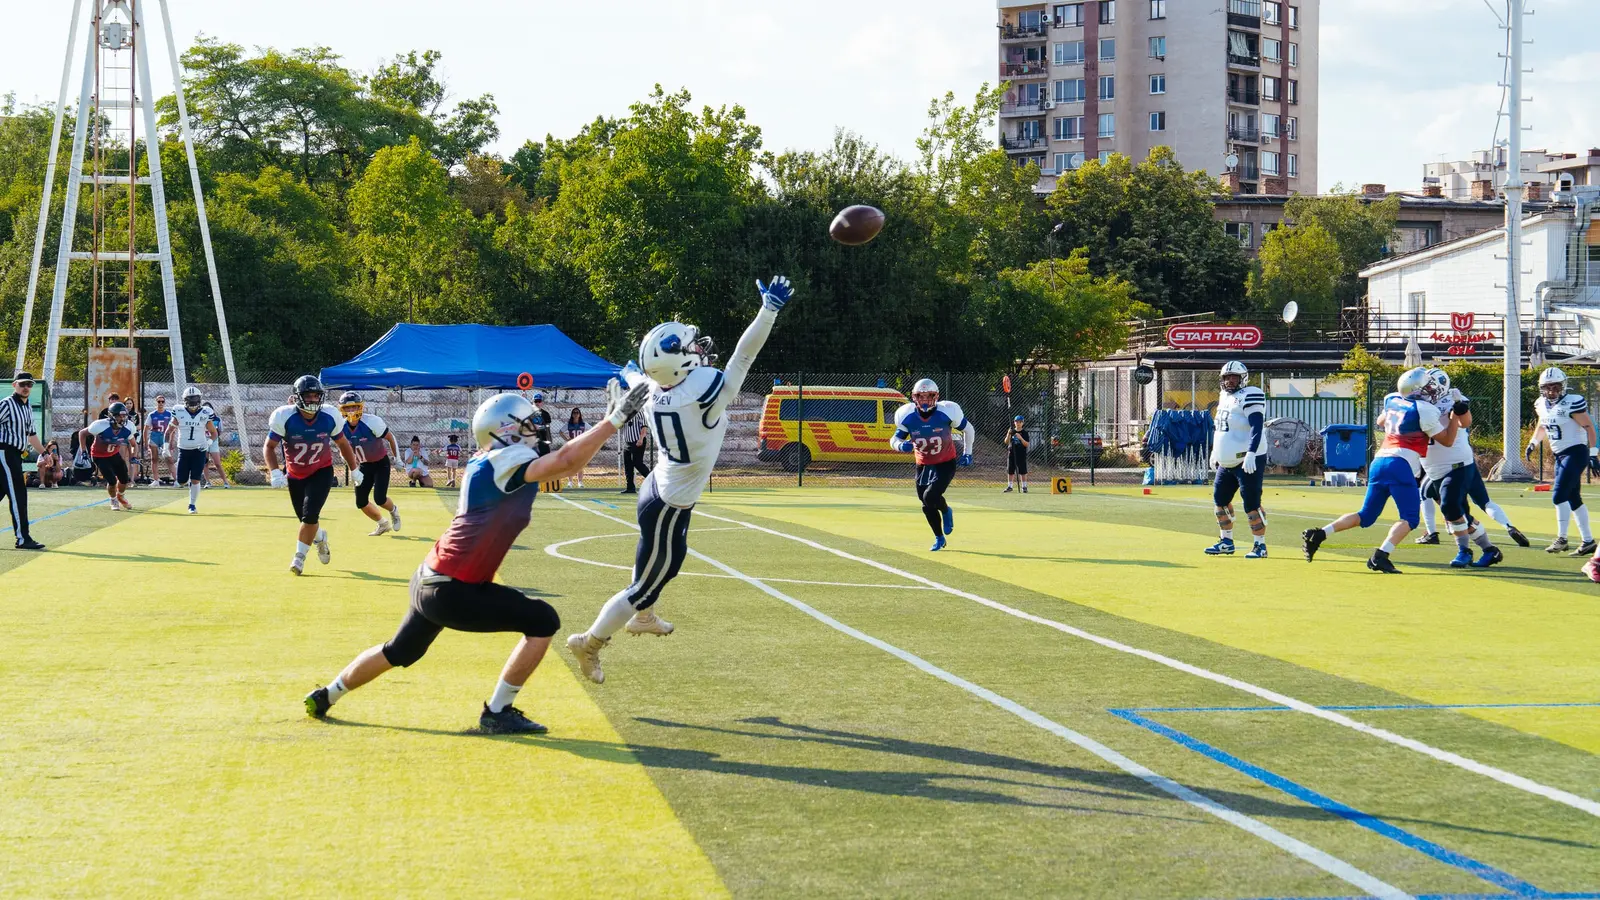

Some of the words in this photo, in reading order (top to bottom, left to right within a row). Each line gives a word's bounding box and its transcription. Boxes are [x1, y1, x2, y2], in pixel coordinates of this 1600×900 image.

[1175, 332, 1211, 341] STAR
[1214, 332, 1253, 341] TRAC
[157, 420, 164, 432] 5
[188, 426, 195, 441] 1
[915, 436, 942, 455] 23
[294, 442, 323, 465] 22
[1057, 478, 1068, 493] G
